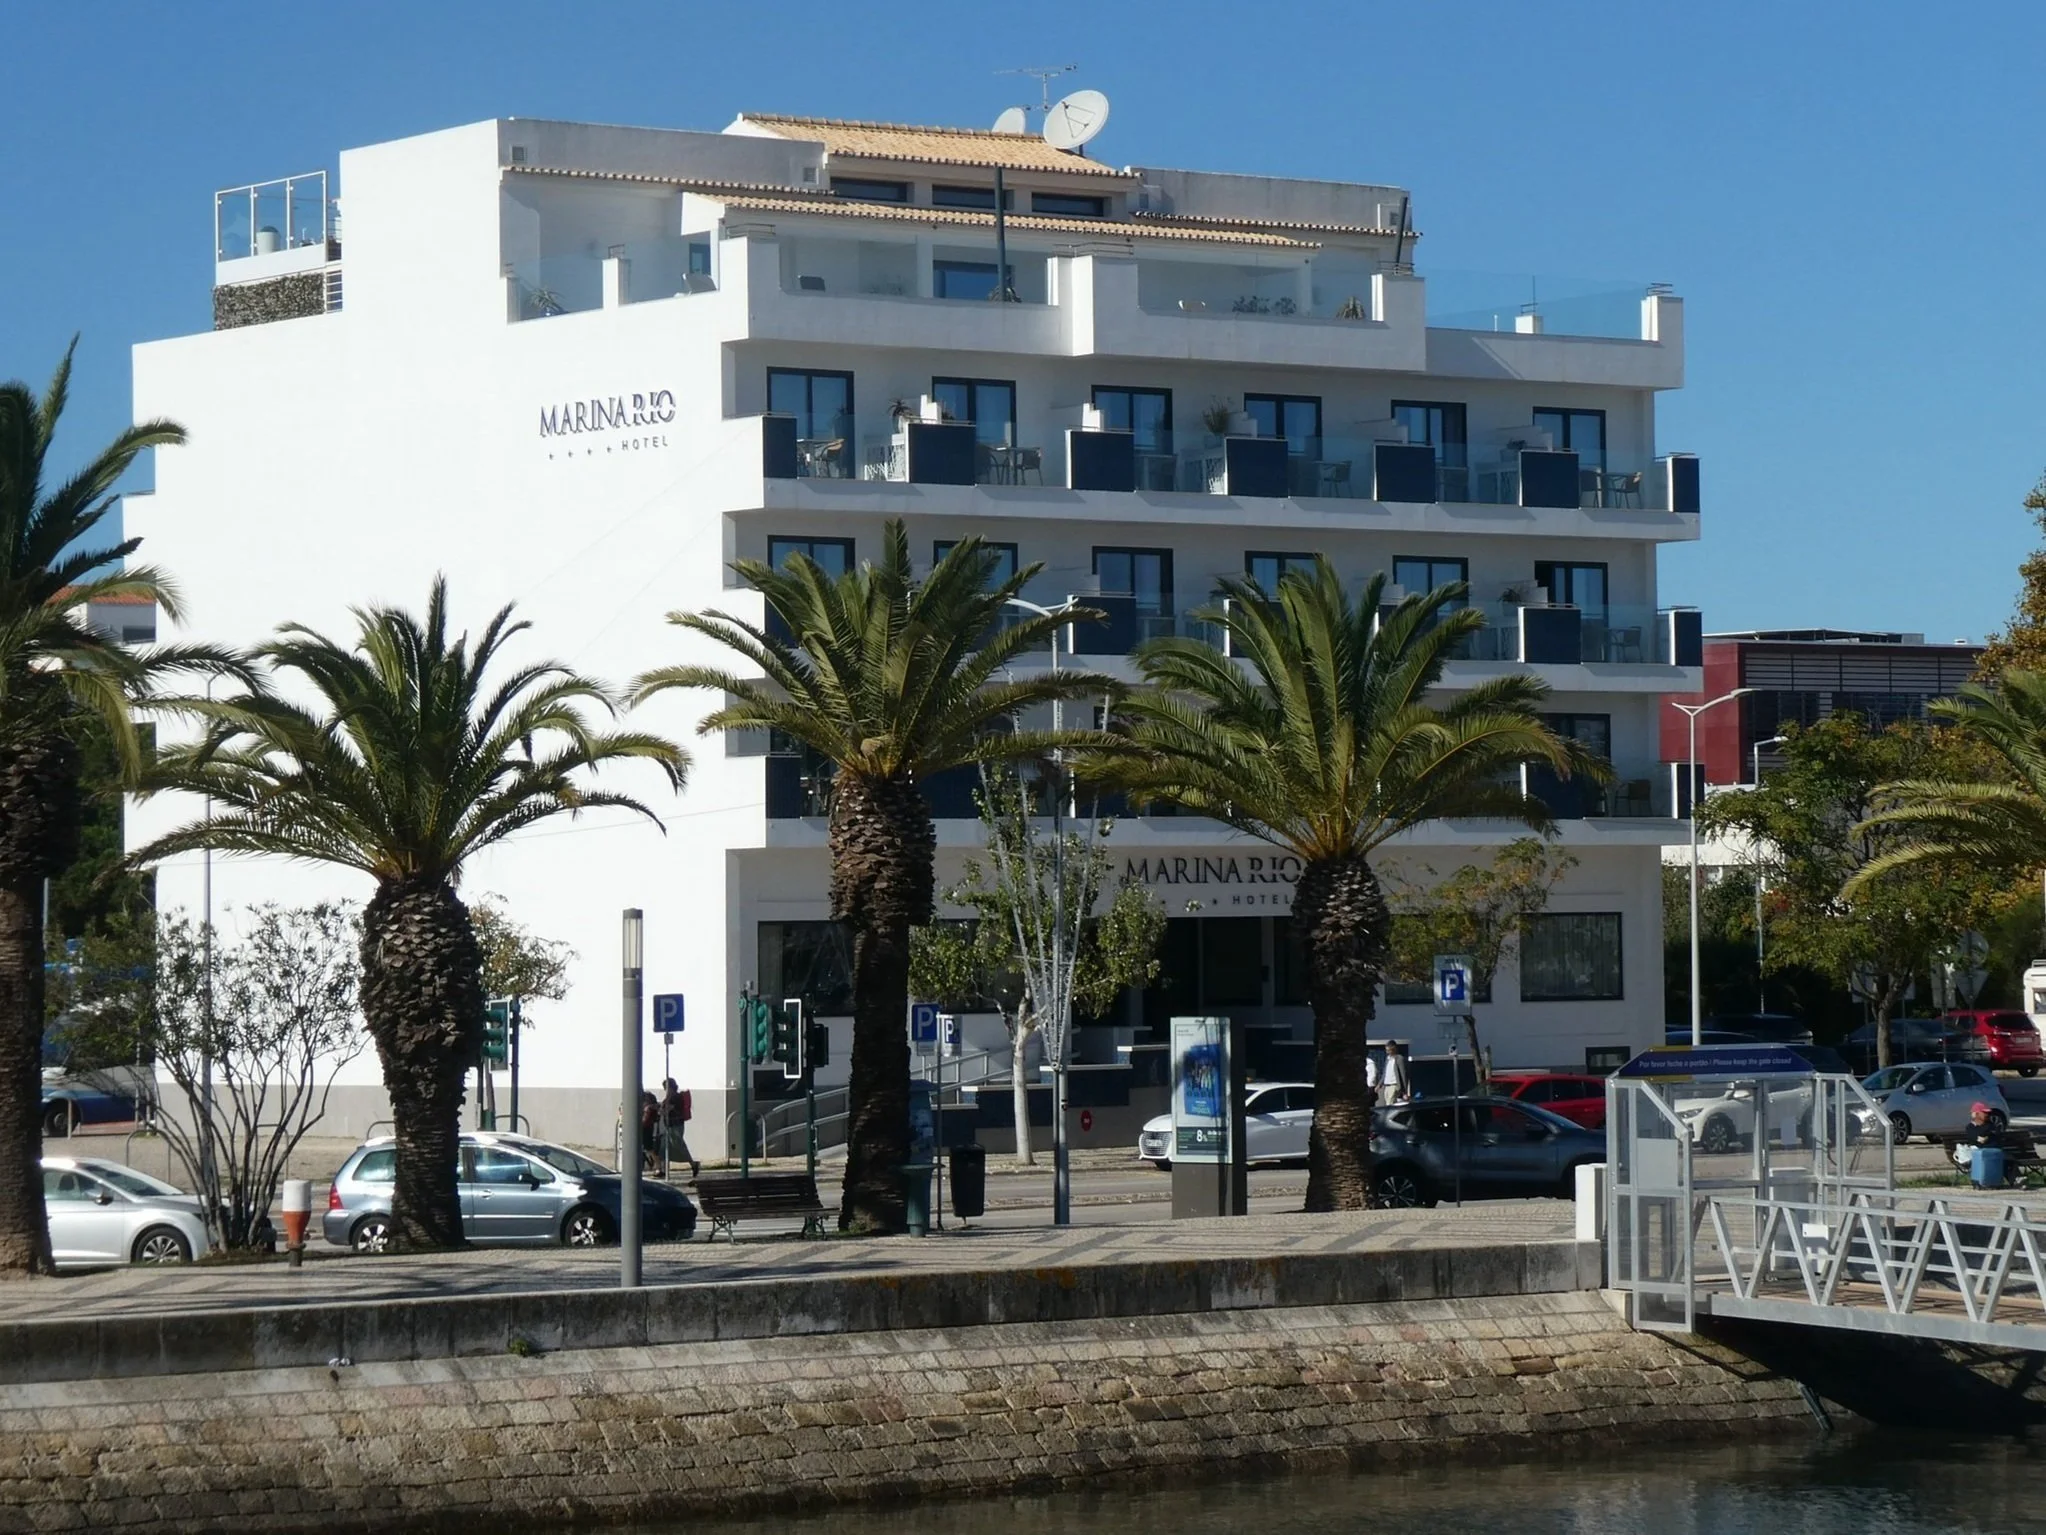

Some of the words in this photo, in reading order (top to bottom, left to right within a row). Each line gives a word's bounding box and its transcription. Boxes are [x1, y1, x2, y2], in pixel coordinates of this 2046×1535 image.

[539, 395, 631, 438] MARINA
[632, 389, 676, 426] RIO
[621, 435, 669, 451] HOTEL
[1125, 856, 1243, 884] MARINA
[1243, 856, 1302, 884] RIO
[1232, 894, 1290, 906] HOTEL
[1445, 973, 1459, 998] P
[660, 998, 677, 1029] P
[917, 1007, 934, 1039] P
[945, 1019, 954, 1042] P
